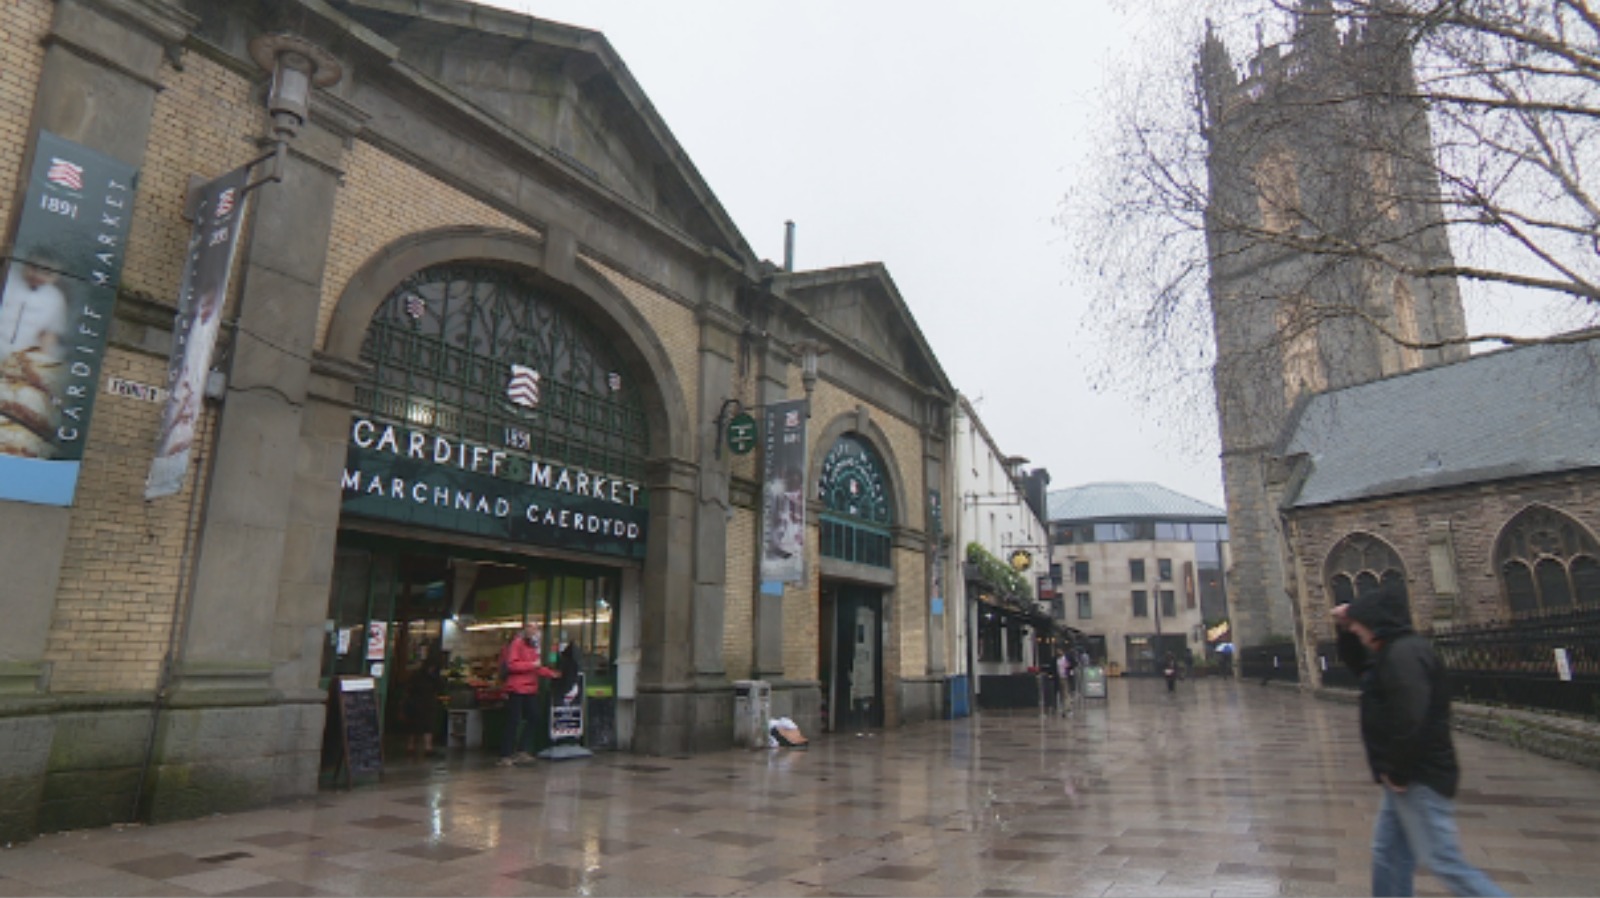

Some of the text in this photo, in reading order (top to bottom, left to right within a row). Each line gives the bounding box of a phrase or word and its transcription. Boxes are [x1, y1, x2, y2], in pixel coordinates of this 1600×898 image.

[40, 194, 78, 220] 1891
[57, 178, 127, 441] CARDIFF MARKET
[353, 419, 639, 506] CARDIFF MARKET
[341, 468, 639, 539] MARCHNAD CAERDYDD
